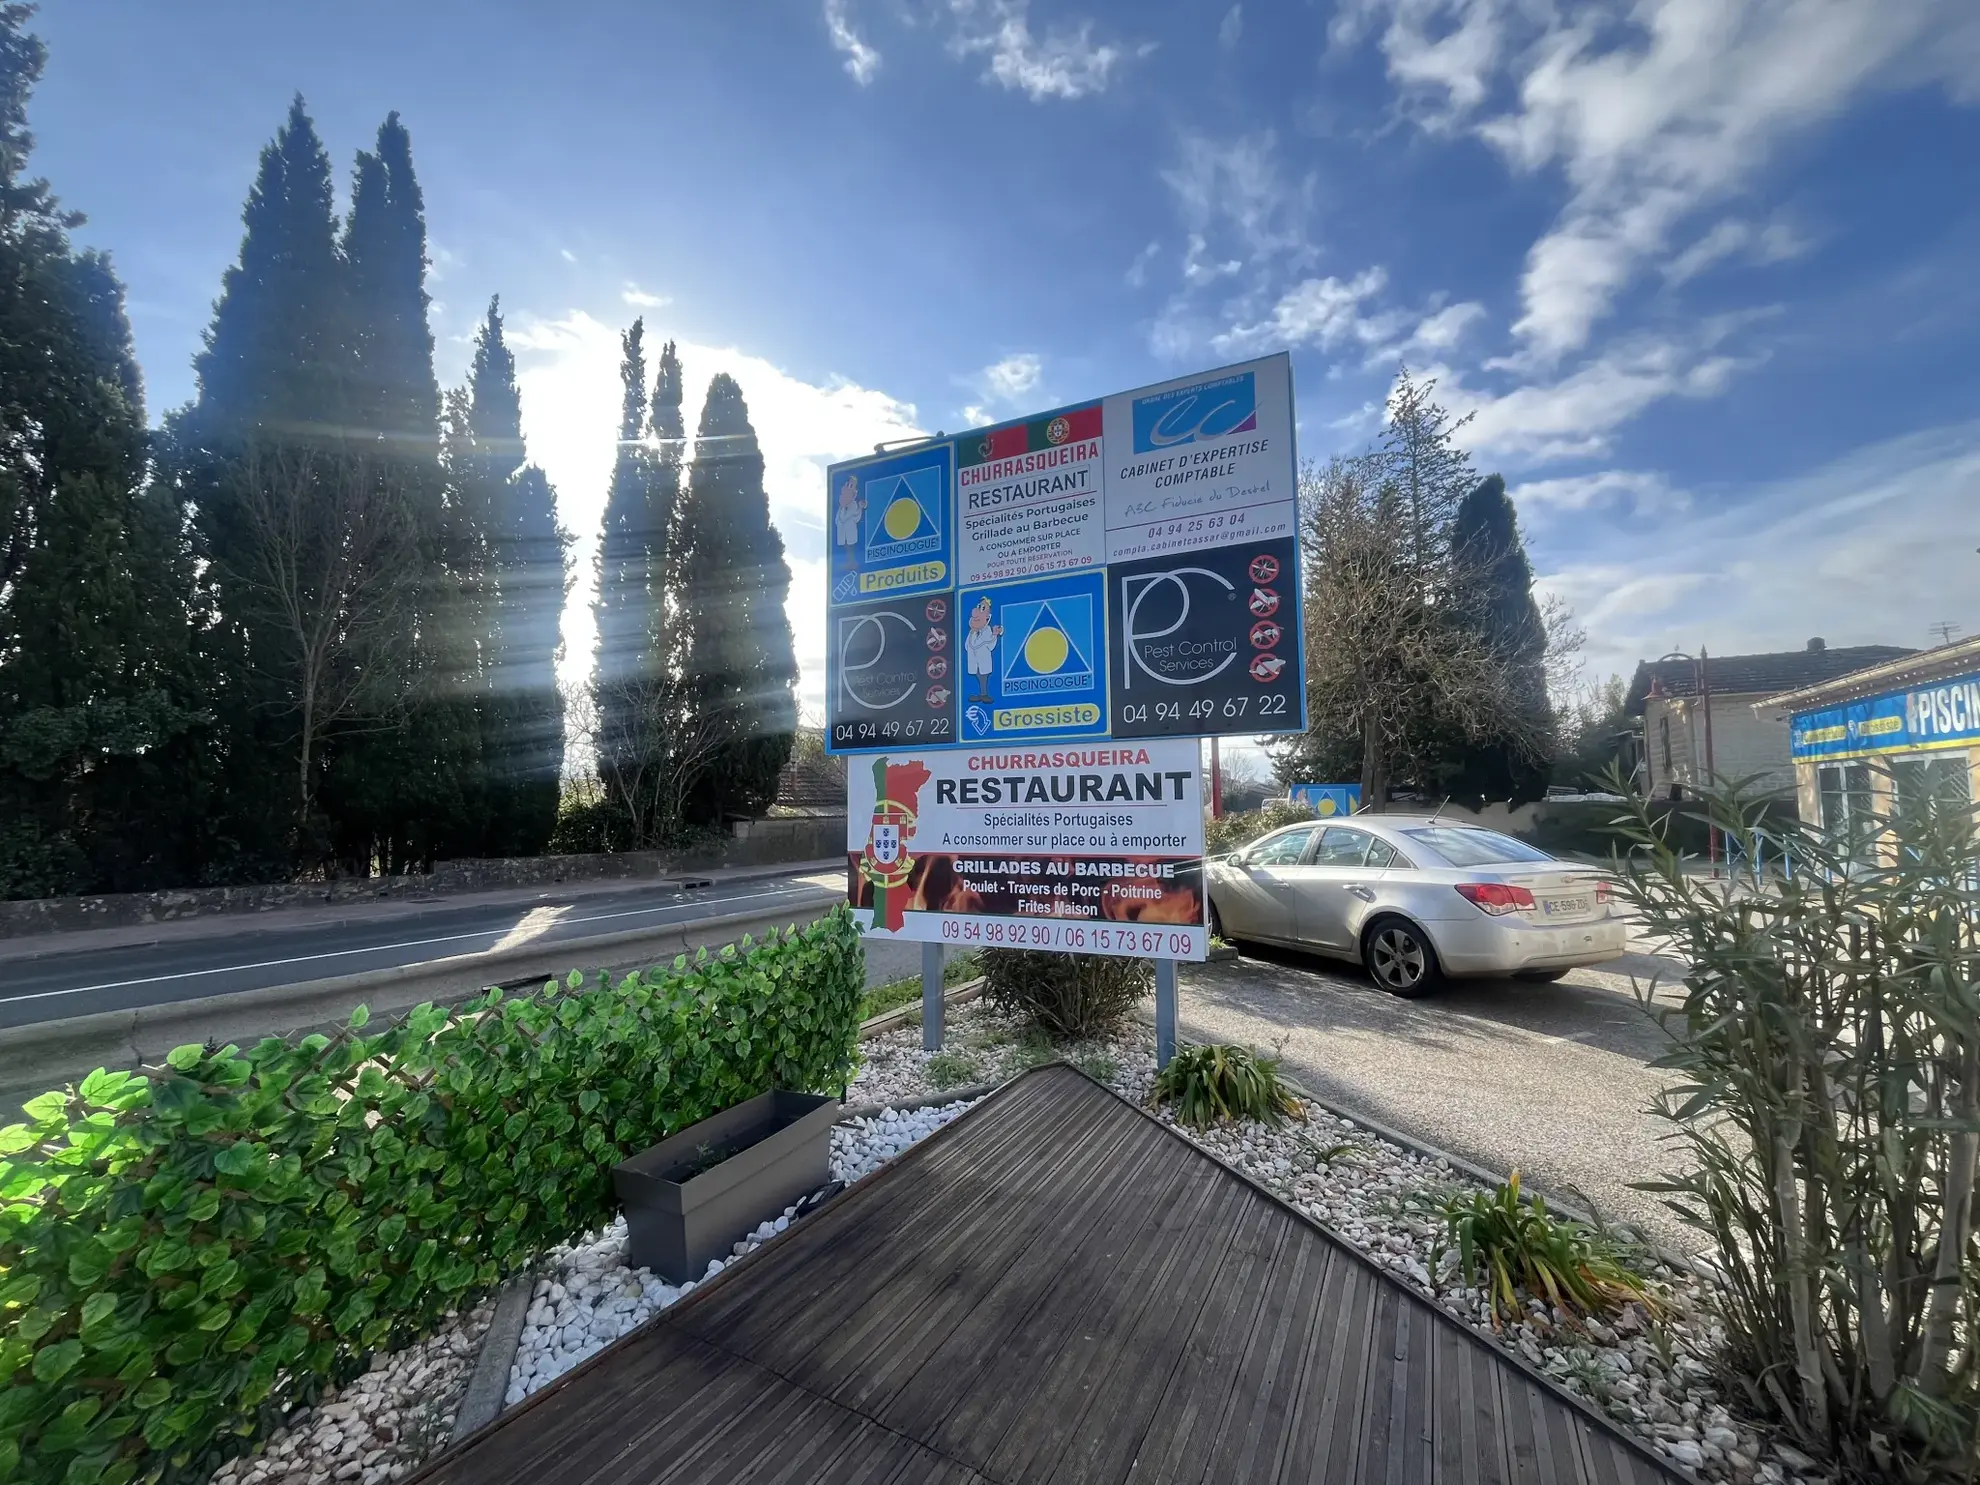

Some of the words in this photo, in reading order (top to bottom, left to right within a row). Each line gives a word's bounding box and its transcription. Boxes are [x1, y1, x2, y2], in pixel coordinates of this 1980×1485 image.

[1176, 386, 1202, 397] EXPERTS
[1204, 376, 1244, 391] COMPTABLES
[961, 442, 1099, 486] CHURRASQUEIRA
[1120, 458, 1175, 480] CABINET
[1179, 439, 1269, 468] D'EXPERTISE
[1155, 463, 1236, 489] COMPTABLE
[968, 470, 1089, 509] RESTAURANT
[1209, 489, 1222, 501] du
[965, 511, 1024, 530] Spécialités
[1026, 497, 1096, 519] Portugaises
[971, 526, 1013, 541] Grillade
[1016, 524, 1030, 534] au
[1033, 513, 1089, 531] Barbecue
[1148, 527, 1162, 539] 04
[1167, 525, 1182, 536] 94
[1188, 520, 1203, 532] 25
[1208, 517, 1224, 528] 63
[1229, 513, 1245, 525] 04
[986, 534, 1036, 551] CONSOMMER
[1037, 532, 1053, 542] SUR
[1055, 528, 1081, 539] PLACE
[998, 551, 1009, 559] OU
[1018, 542, 1061, 556] EMPORTER
[970, 574, 980, 582] 09
[982, 572, 992, 580] 54
[1005, 568, 1015, 576] 92
[1016, 566, 1027, 575] 90
[1034, 563, 1045, 571] 06
[1046, 562, 1055, 570] 15
[1057, 560, 1066, 568] 73
[1068, 558, 1079, 566] 67
[1081, 555, 1092, 565] 09
[987, 561, 1004, 569] POUR
[1006, 557, 1026, 566] TOUTE
[866, 566, 939, 589] Produits
[1144, 644, 1174, 659] Pest
[1178, 637, 1237, 656] Control
[1159, 657, 1214, 672] Services
[999, 706, 1093, 727] Grossiste
[1123, 704, 1147, 723] 04
[1155, 702, 1180, 721] 94
[1188, 699, 1214, 718] 49
[1223, 697, 1248, 717] 67
[1258, 694, 1286, 715] 22
[836, 724, 853, 740] 04
[858, 723, 876, 739] 94
[882, 721, 900, 737] 49
[905, 719, 924, 736] 67
[930, 717, 949, 735] 22
[968, 749, 1150, 771] CHURRASQUEIRA
[936, 771, 1191, 804] RESTAURANT
[984, 812, 1050, 829] Spécialités
[1054, 812, 1133, 829] Portugaises
[942, 832, 950, 845] A
[953, 834, 1024, 846] consommer
[1027, 835, 1047, 846] sur
[1051, 833, 1085, 850] place
[1089, 836, 1106, 847] ou
[1110, 832, 1118, 847] à
[1122, 833, 1187, 850] emporter
[952, 860, 1041, 875] GRILLADES
[1046, 861, 1069, 876] AU
[1075, 862, 1175, 878] BARBECUE
[963, 879, 998, 893] Poulet
[1008, 881, 1050, 895] Travers
[1053, 882, 1068, 896] de
[1071, 882, 1100, 897] Porc
[1111, 883, 1162, 899] Poitrine
[1018, 899, 1051, 913] Frites
[1054, 901, 1098, 916] Maison
[942, 920, 959, 938] 09
[964, 922, 980, 940] 54
[986, 923, 1003, 941] 98
[1008, 924, 1027, 943] 92
[1031, 925, 1050, 944] 90
[1055, 926, 1060, 945] /
[1065, 927, 1085, 947] 06
[1091, 929, 1110, 949] 15
[1116, 930, 1136, 951] 73
[1142, 932, 1163, 952] 67
[1169, 933, 1191, 954] 09
